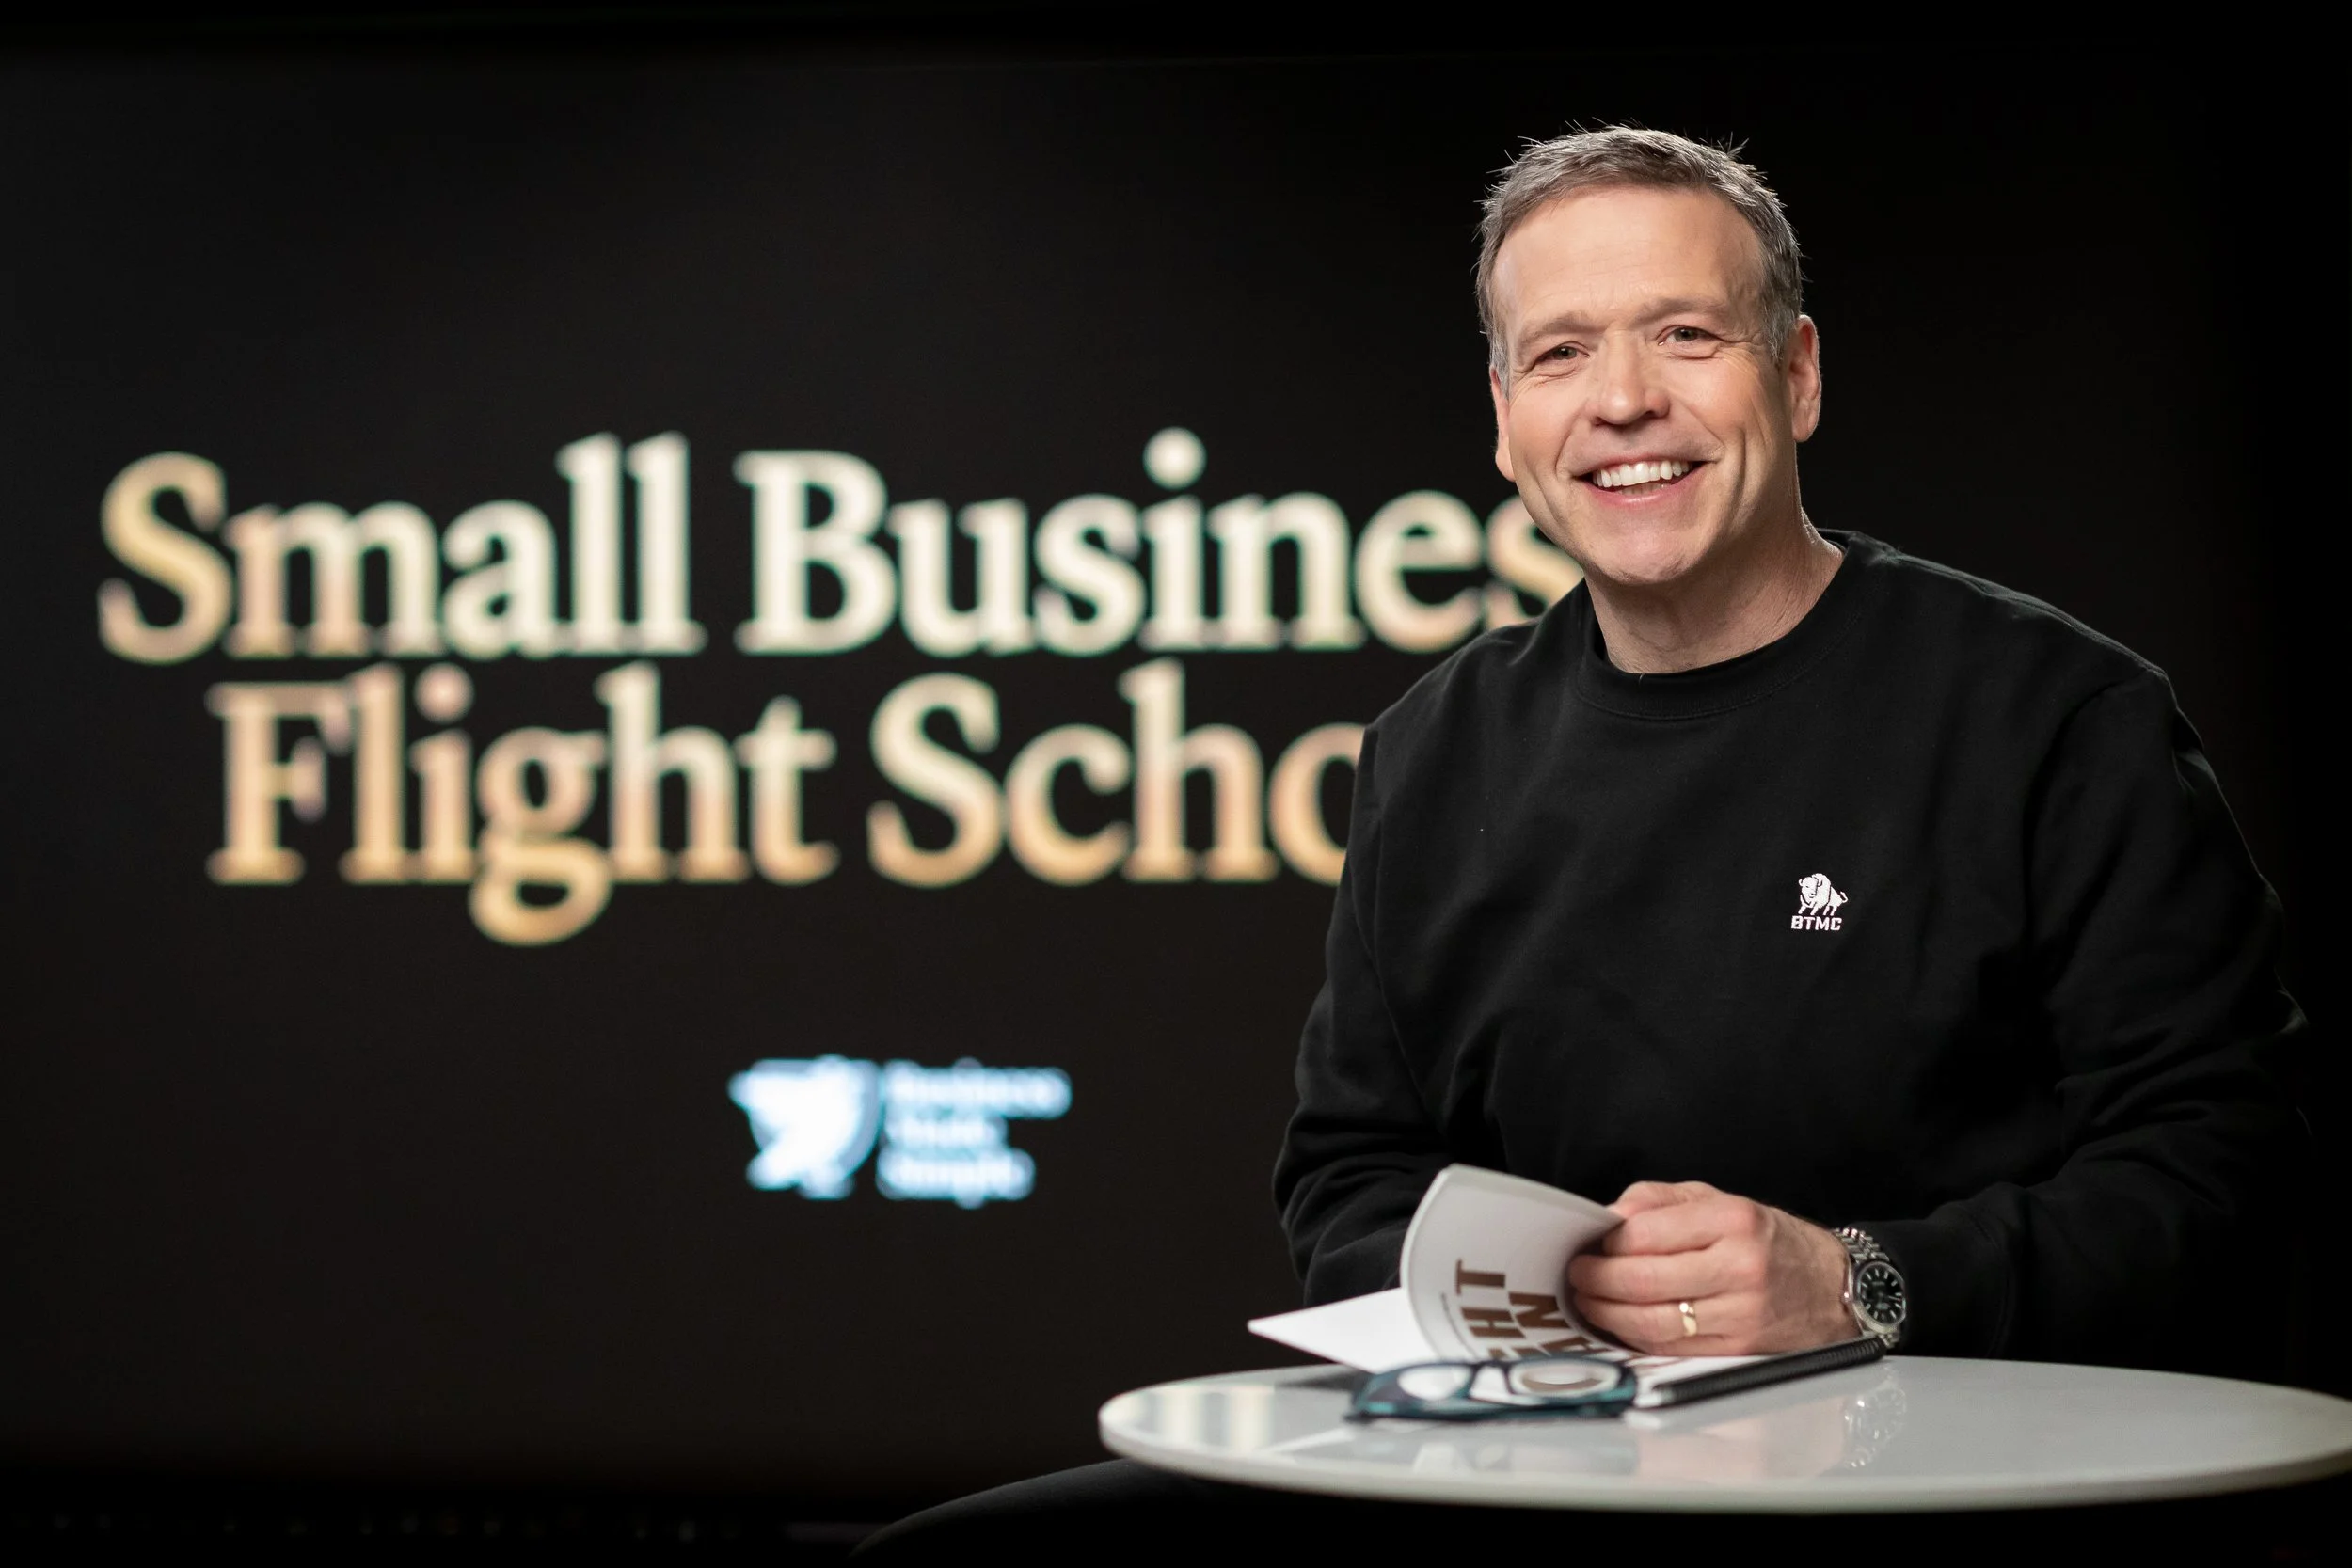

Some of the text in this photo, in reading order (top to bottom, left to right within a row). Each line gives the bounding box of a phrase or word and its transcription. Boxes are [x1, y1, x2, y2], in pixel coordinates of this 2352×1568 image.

[98, 427, 1583, 664] Small Busines
[205, 658, 1364, 945] Flight Scho
[1790, 915, 1842, 931] BTMC
[1507, 1291, 1613, 1358] AN
